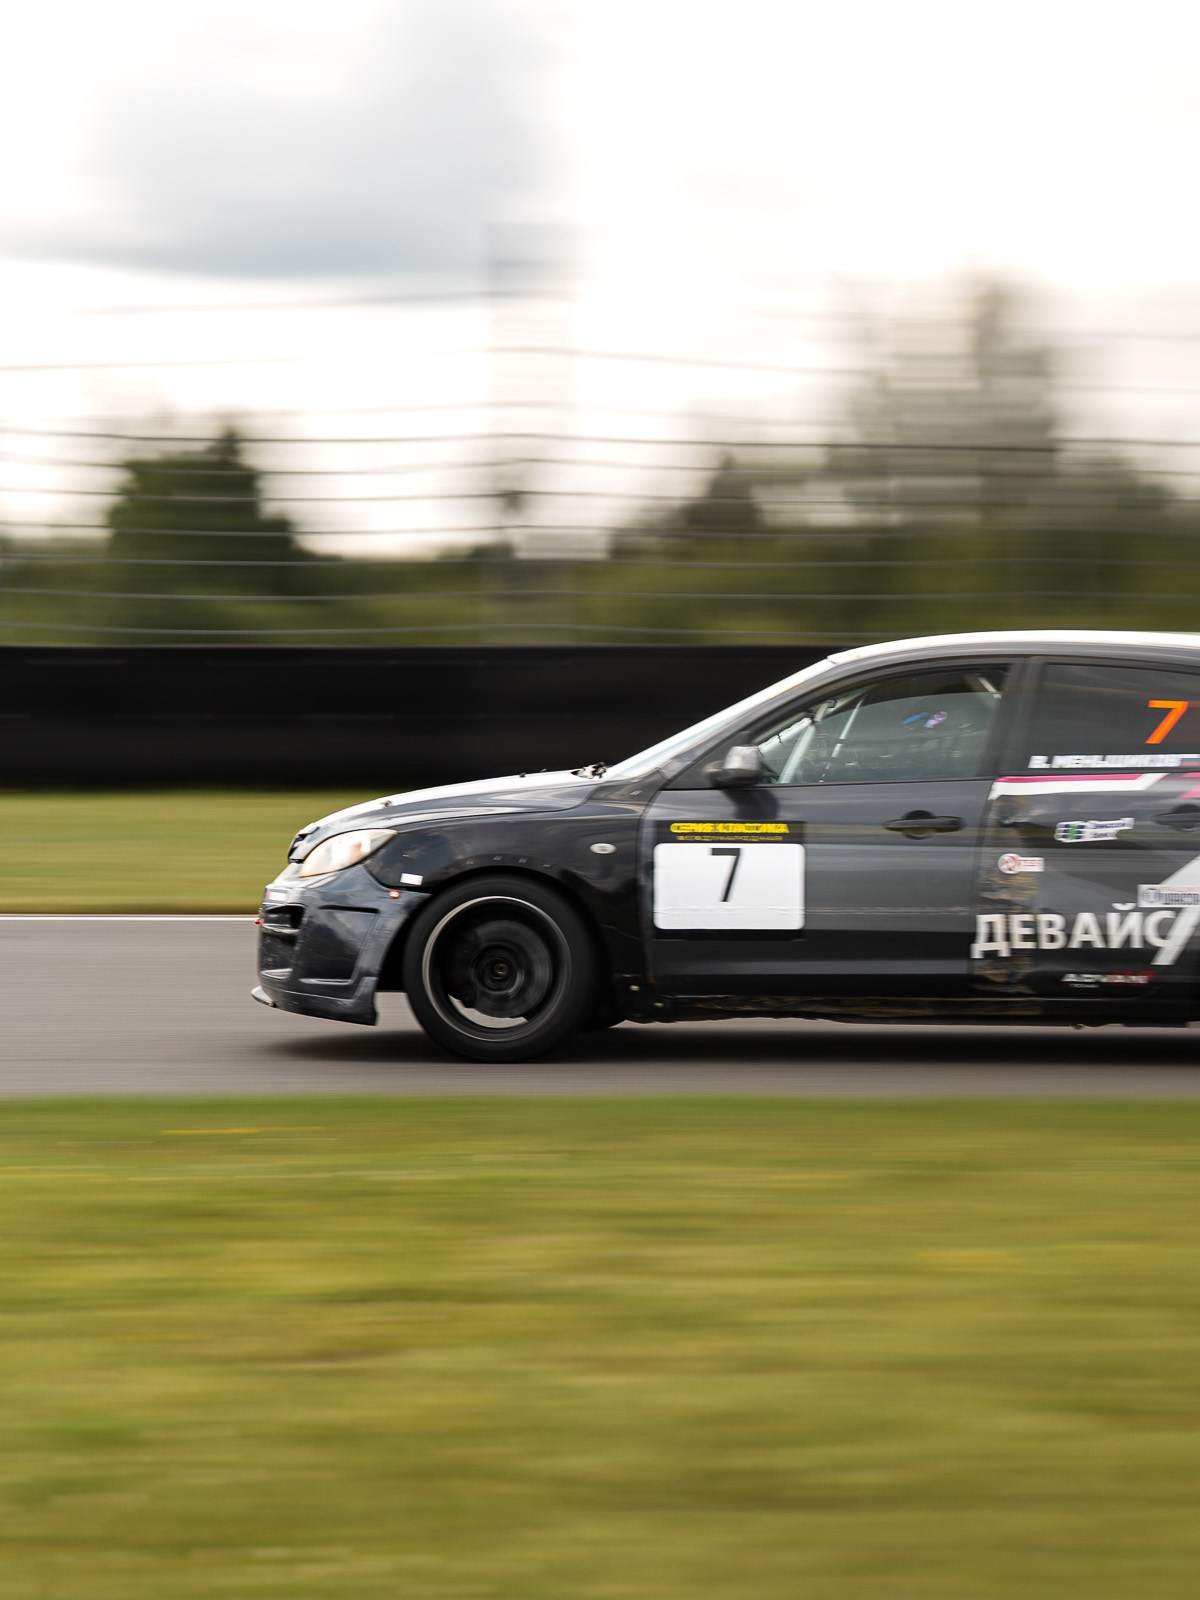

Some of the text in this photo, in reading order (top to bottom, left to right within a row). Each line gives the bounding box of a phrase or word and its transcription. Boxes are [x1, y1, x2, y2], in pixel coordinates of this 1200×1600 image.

[1145, 699, 1190, 744] 7
[709, 847, 742, 903] 7
[969, 902, 1176, 959] ДЕВАЙС
